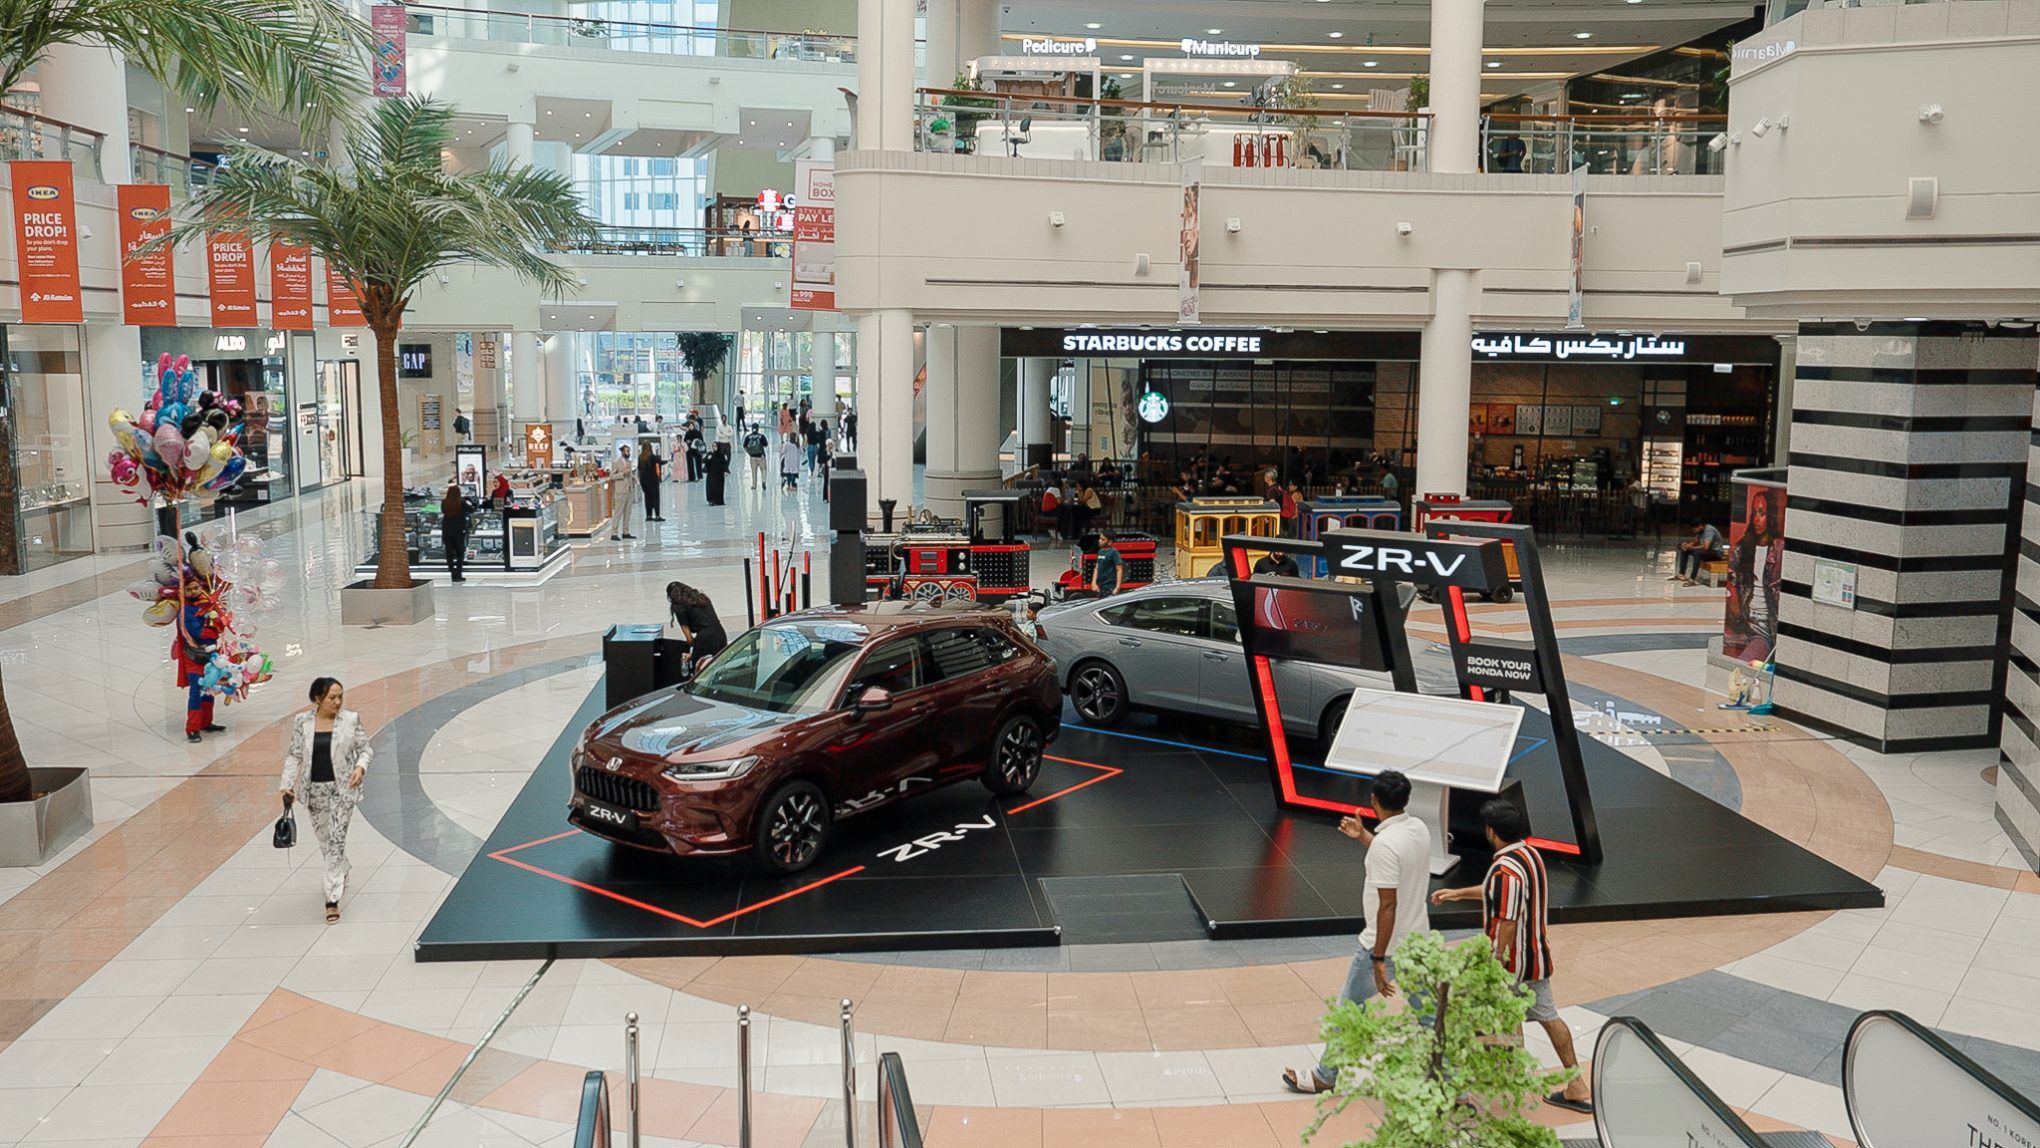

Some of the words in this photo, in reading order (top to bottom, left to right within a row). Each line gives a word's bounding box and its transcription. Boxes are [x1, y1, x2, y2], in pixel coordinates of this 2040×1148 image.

[1022, 38, 1086, 53] Pedicure
[1193, 40, 1260, 55] Manicure
[812, 188, 835, 197] BOX
[24, 213, 62, 225] PRICE
[798, 214, 818, 222] PAY
[25, 226, 67, 237] DROP!
[213, 242, 244, 252] PRICE
[214, 253, 247, 262] DROP!
[214, 335, 246, 351] ALDO
[1063, 335, 1182, 351] STARBUCKS
[1185, 336, 1261, 352] COFFEE
[1470, 335, 1551, 357] كافيه
[403, 353, 425, 369] GAP
[1340, 544, 1466, 577] ZR-V
[1467, 656, 1499, 668] BOOK
[1500, 660, 1531, 671] YOUR
[1467, 666, 1503, 677] HONDA
[1504, 670, 1531, 680] NOW
[590, 804, 626, 824] ZR-V
[876, 814, 997, 862] ZR-V
